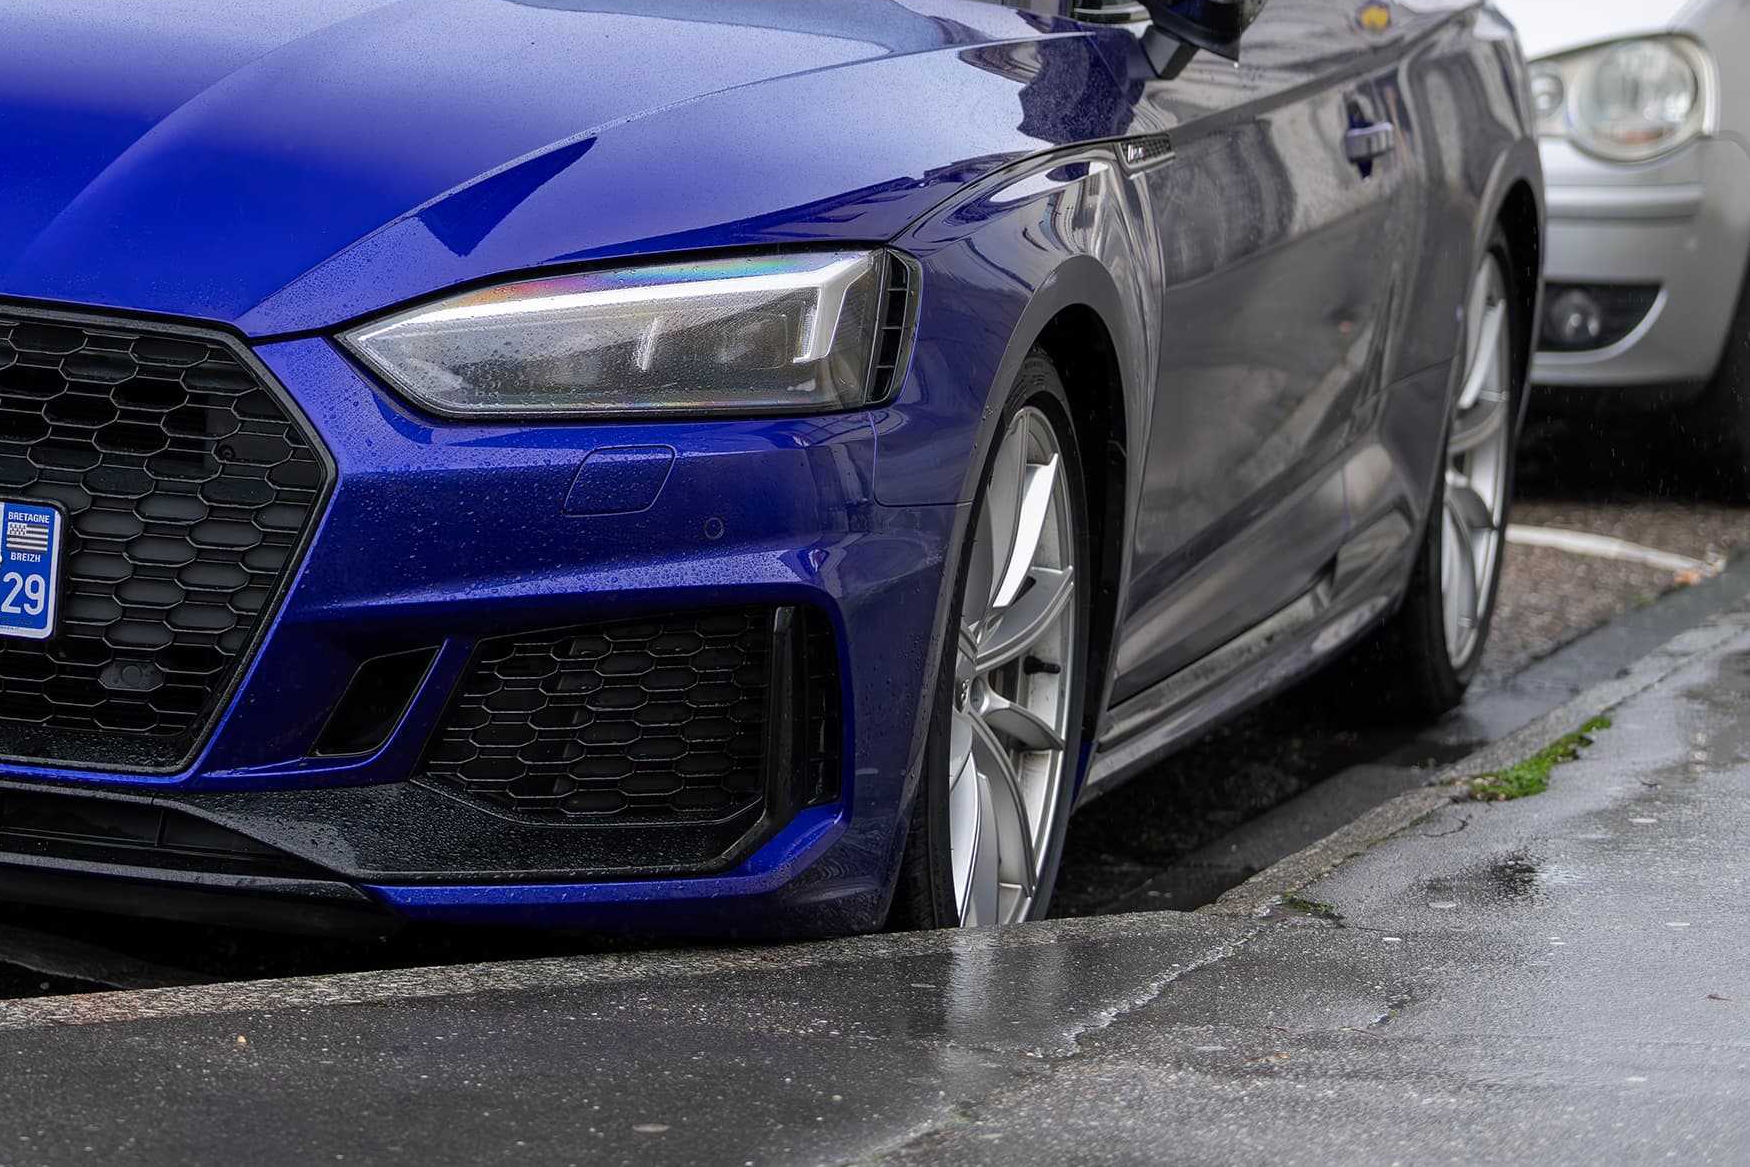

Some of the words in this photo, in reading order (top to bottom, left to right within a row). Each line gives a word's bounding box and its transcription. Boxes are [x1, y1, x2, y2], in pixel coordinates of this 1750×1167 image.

[8, 511, 50, 524] BRETAGNE
[10, 551, 41, 563] BREIZH
[0, 571, 46, 616] 29
